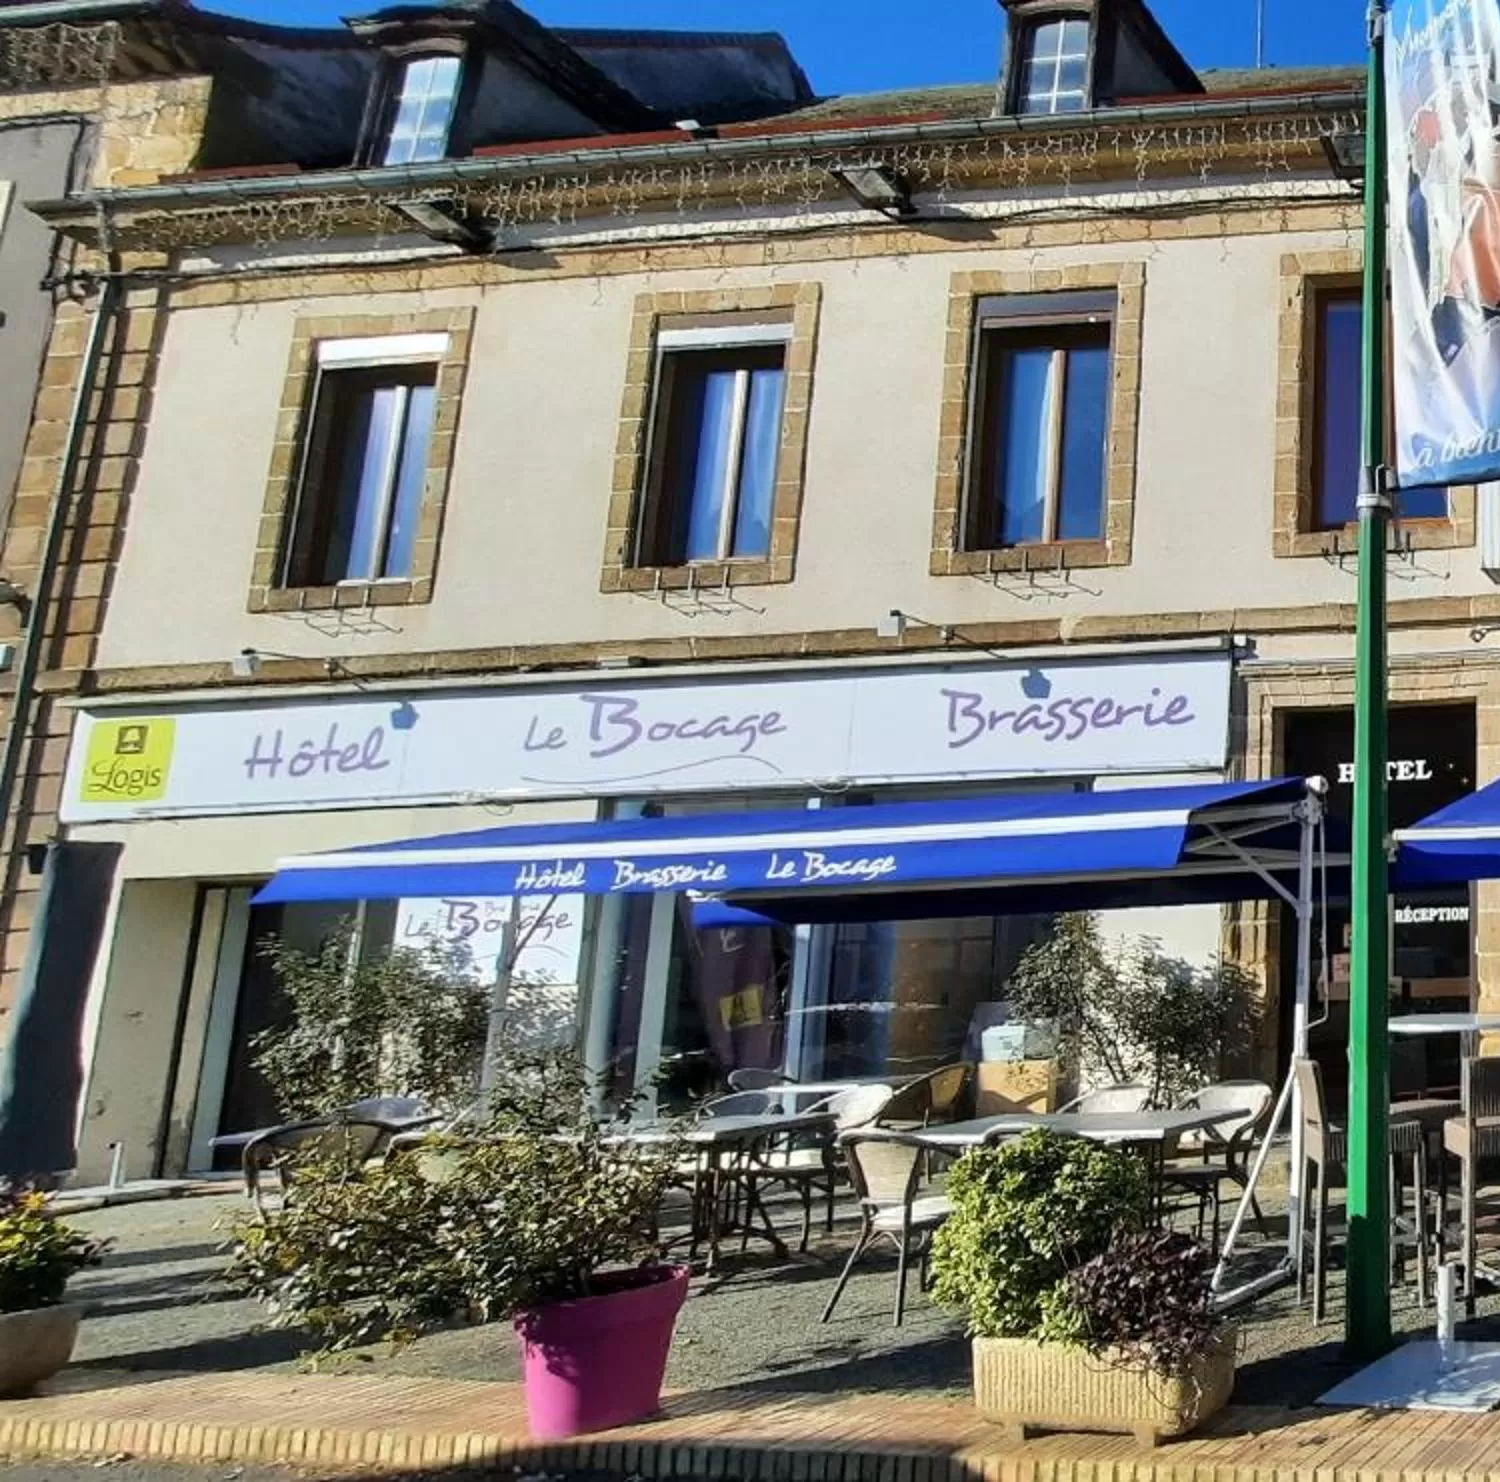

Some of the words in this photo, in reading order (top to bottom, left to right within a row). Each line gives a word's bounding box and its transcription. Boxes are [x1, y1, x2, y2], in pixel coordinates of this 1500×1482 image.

[242, 722, 391, 780] Hôtel
[522, 714, 569, 751] Le
[578, 693, 788, 759] Bocage
[939, 686, 1196, 749] Brasserie
[87, 757, 161, 796] Logis
[1337, 759, 1433, 783] HTEL
[514, 858, 587, 891] Hôtel
[609, 858, 729, 891] Brasserie
[765, 852, 797, 881] Le
[799, 849, 898, 883] Bocage
[441, 898, 573, 943] Boage
[1394, 904, 1470, 924] RÉCEPTION
